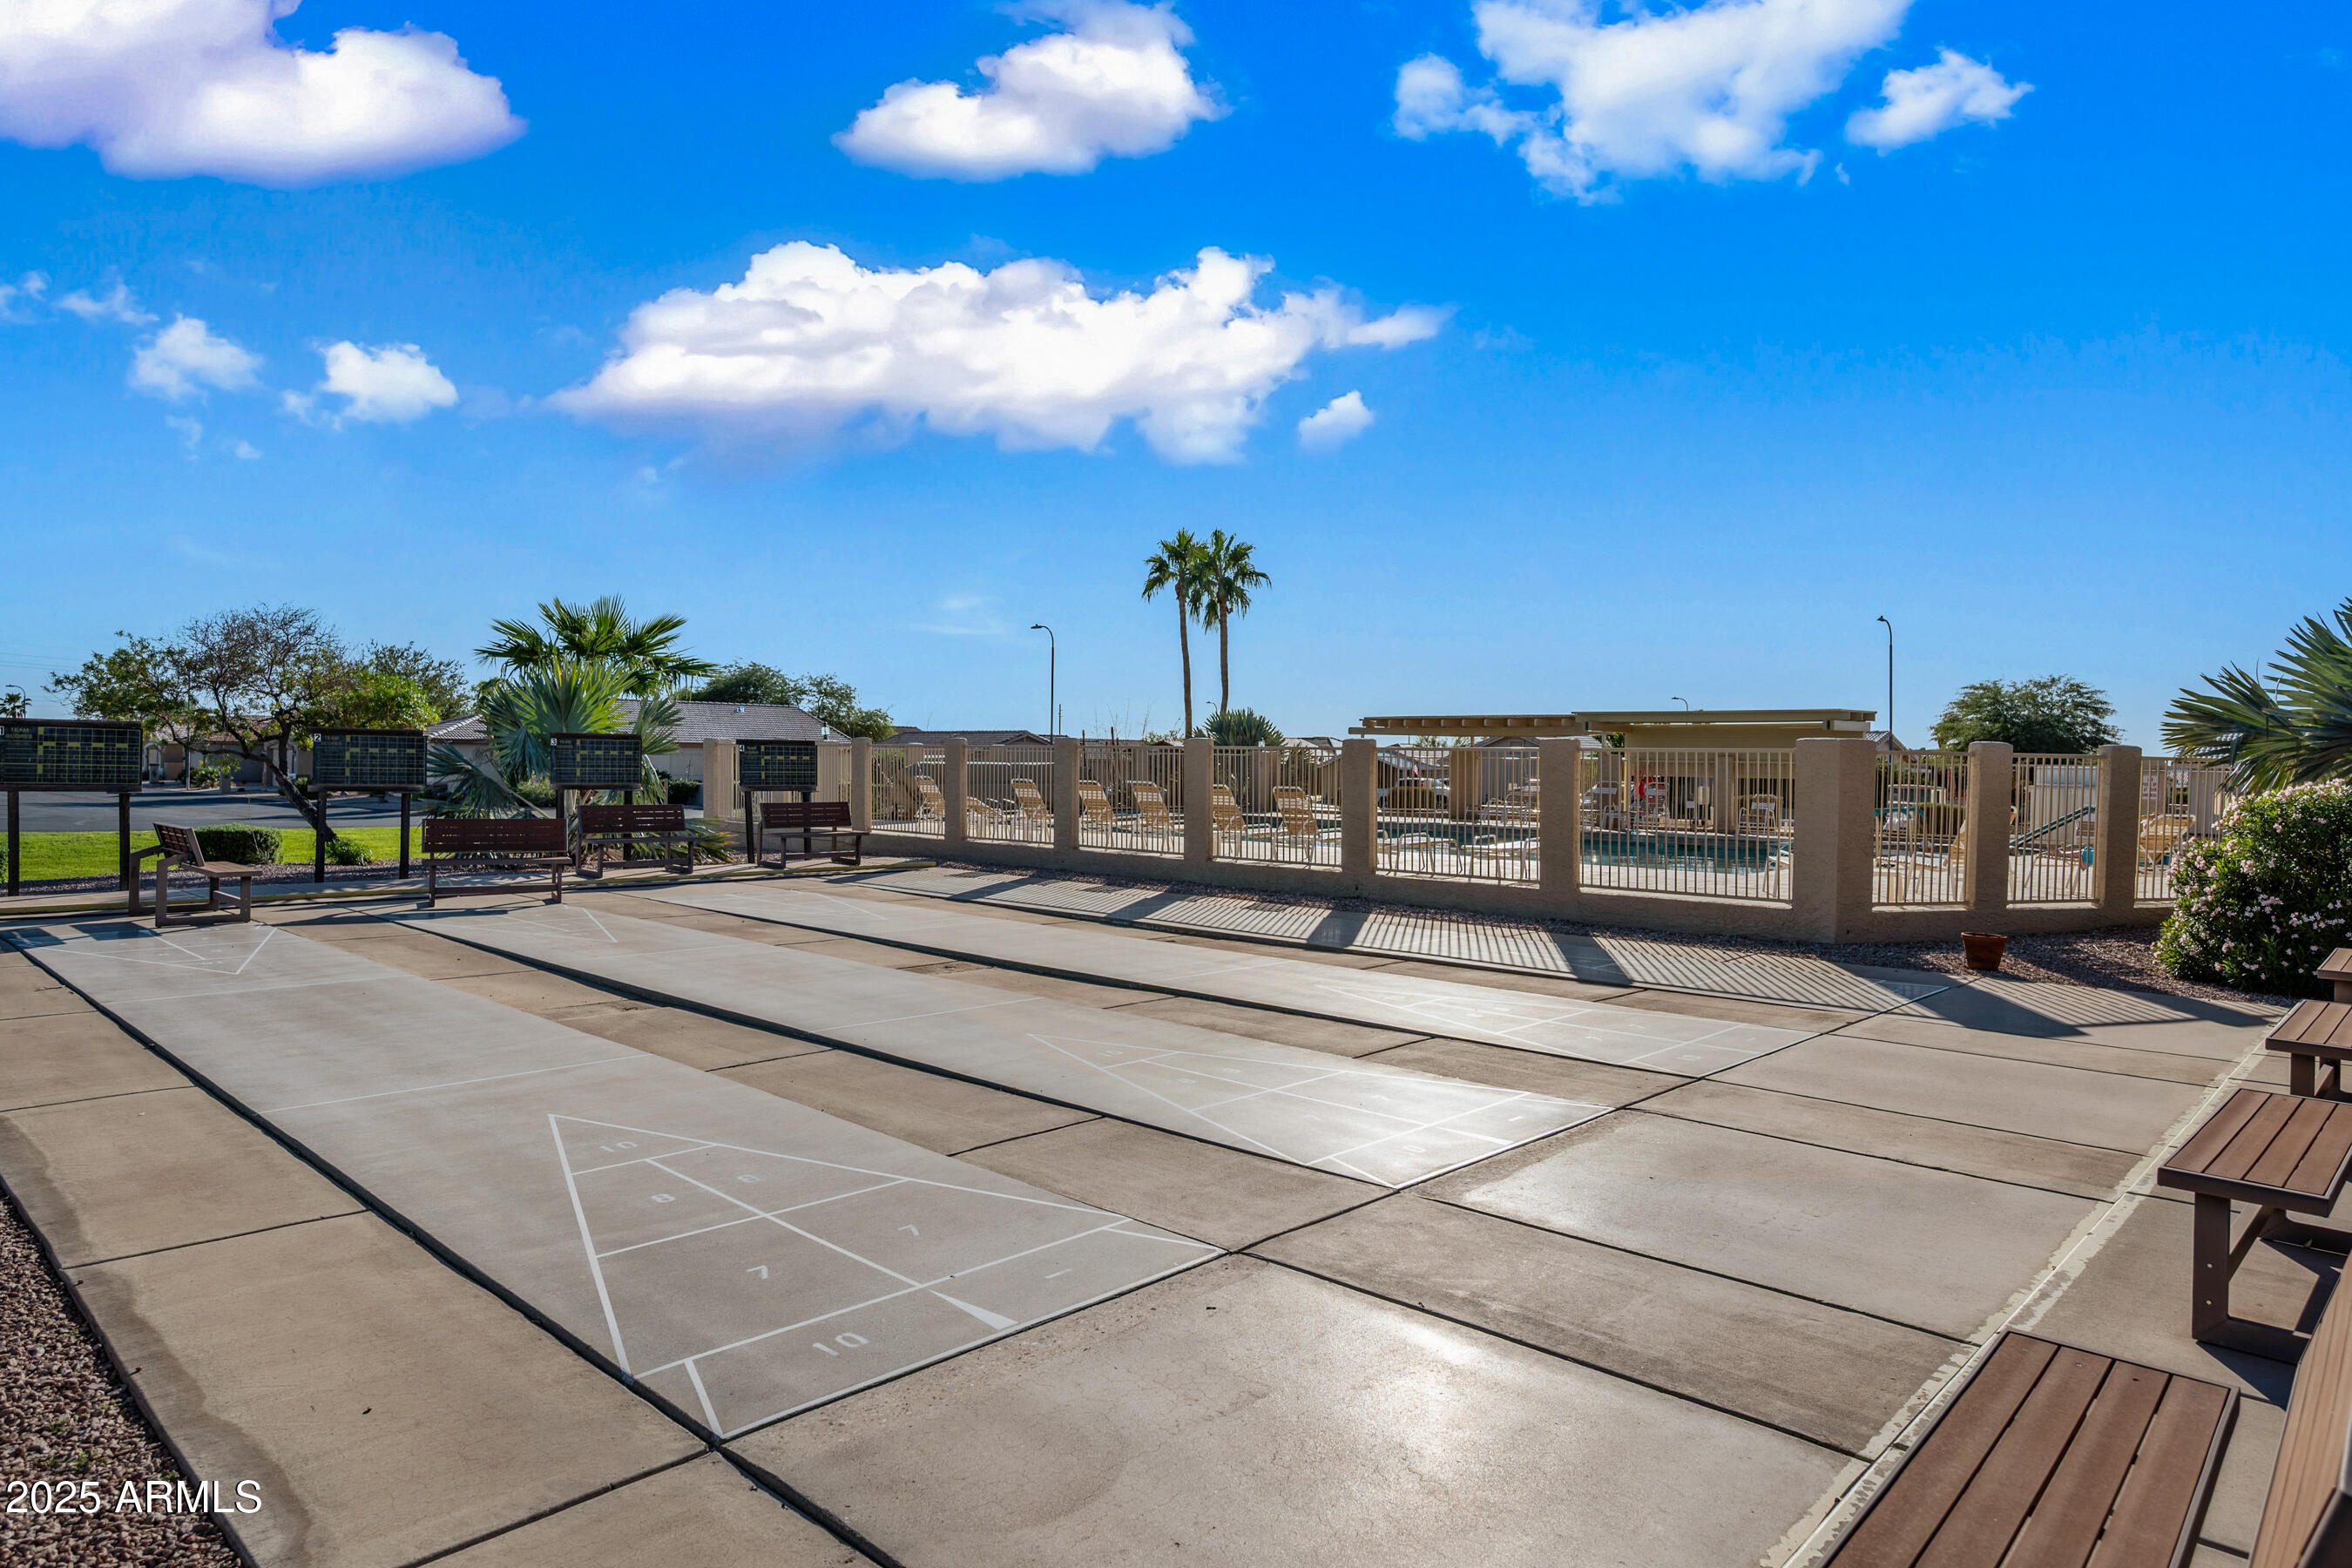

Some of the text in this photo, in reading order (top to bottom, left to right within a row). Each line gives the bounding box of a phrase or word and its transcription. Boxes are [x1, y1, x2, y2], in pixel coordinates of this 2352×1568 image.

[598, 1140, 639, 1152] 10
[650, 1193, 677, 1204] 8
[897, 1224, 920, 1237] 7
[746, 1265, 769, 1280] 7
[812, 1332, 870, 1356] 10
